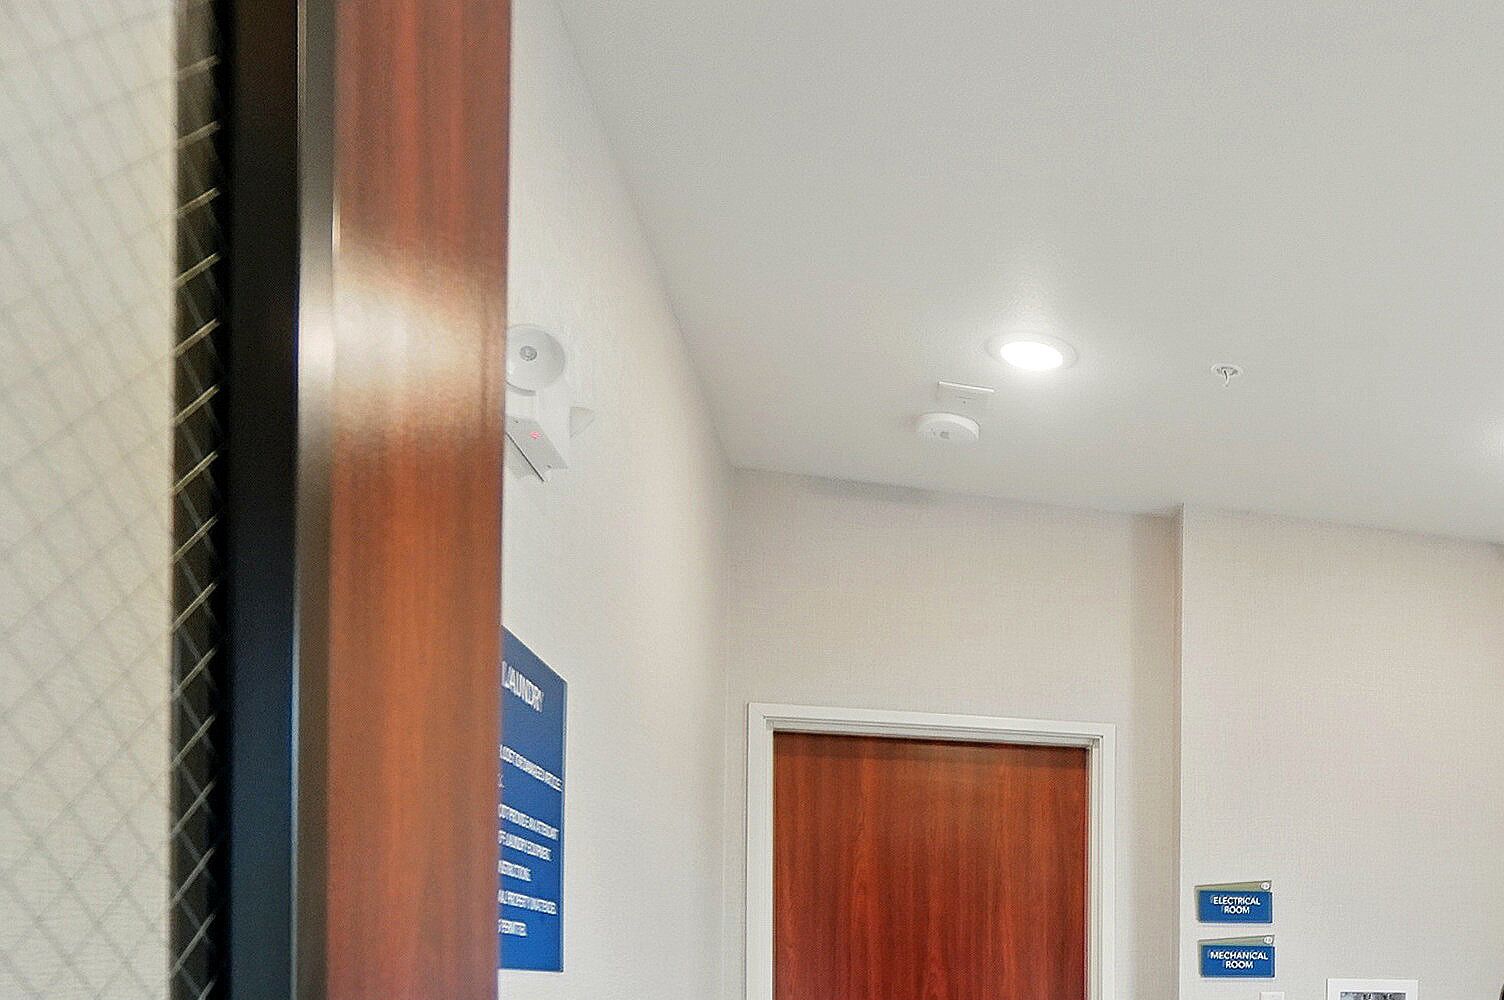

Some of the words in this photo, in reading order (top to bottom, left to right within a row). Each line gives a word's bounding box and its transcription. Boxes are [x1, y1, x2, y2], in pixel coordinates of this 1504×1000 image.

[502, 660, 544, 712] LAUNDRY
[1212, 895, 1261, 906] ELECTRICAL
[1223, 906, 1251, 914] ROOM
[1209, 950, 1269, 961] MECHANICAL
[1225, 960, 1254, 970] ROOM
